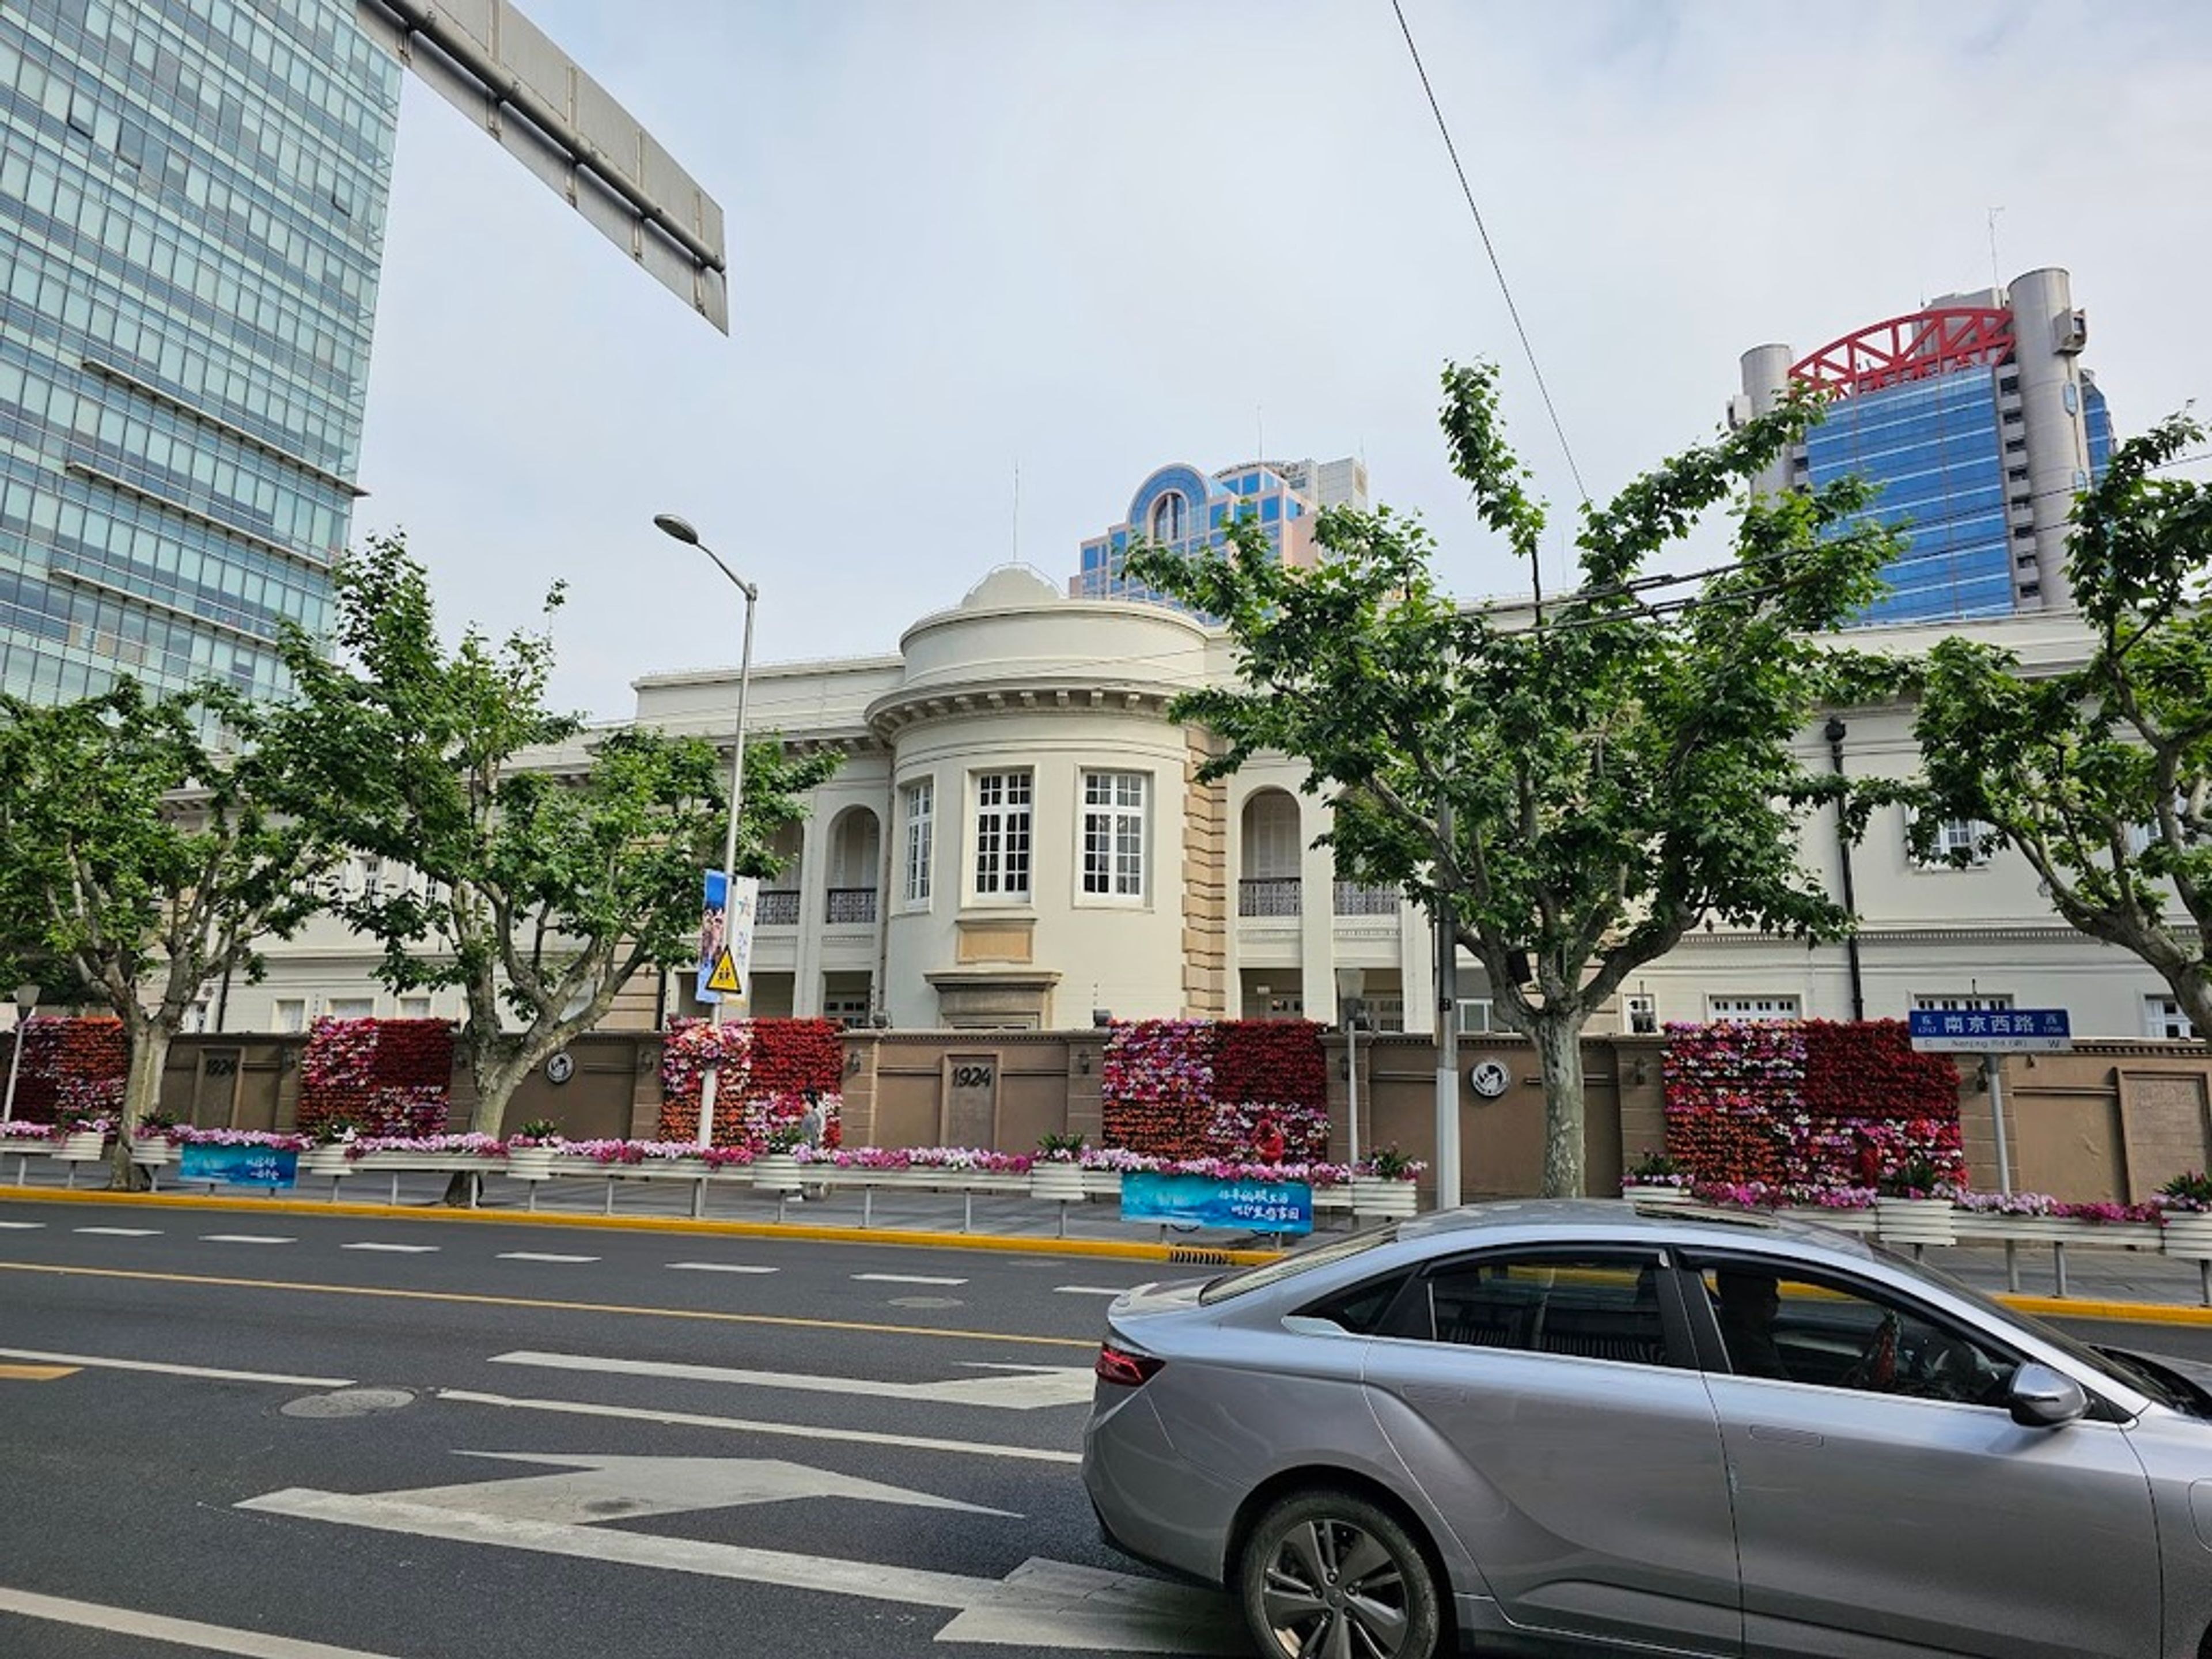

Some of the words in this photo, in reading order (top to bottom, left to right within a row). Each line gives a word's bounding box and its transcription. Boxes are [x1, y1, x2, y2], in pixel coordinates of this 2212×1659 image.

[1944, 1014, 2035, 1034] 南京西路
[2048, 1039, 2060, 1048] W
[952, 1067, 991, 1087] 1924
